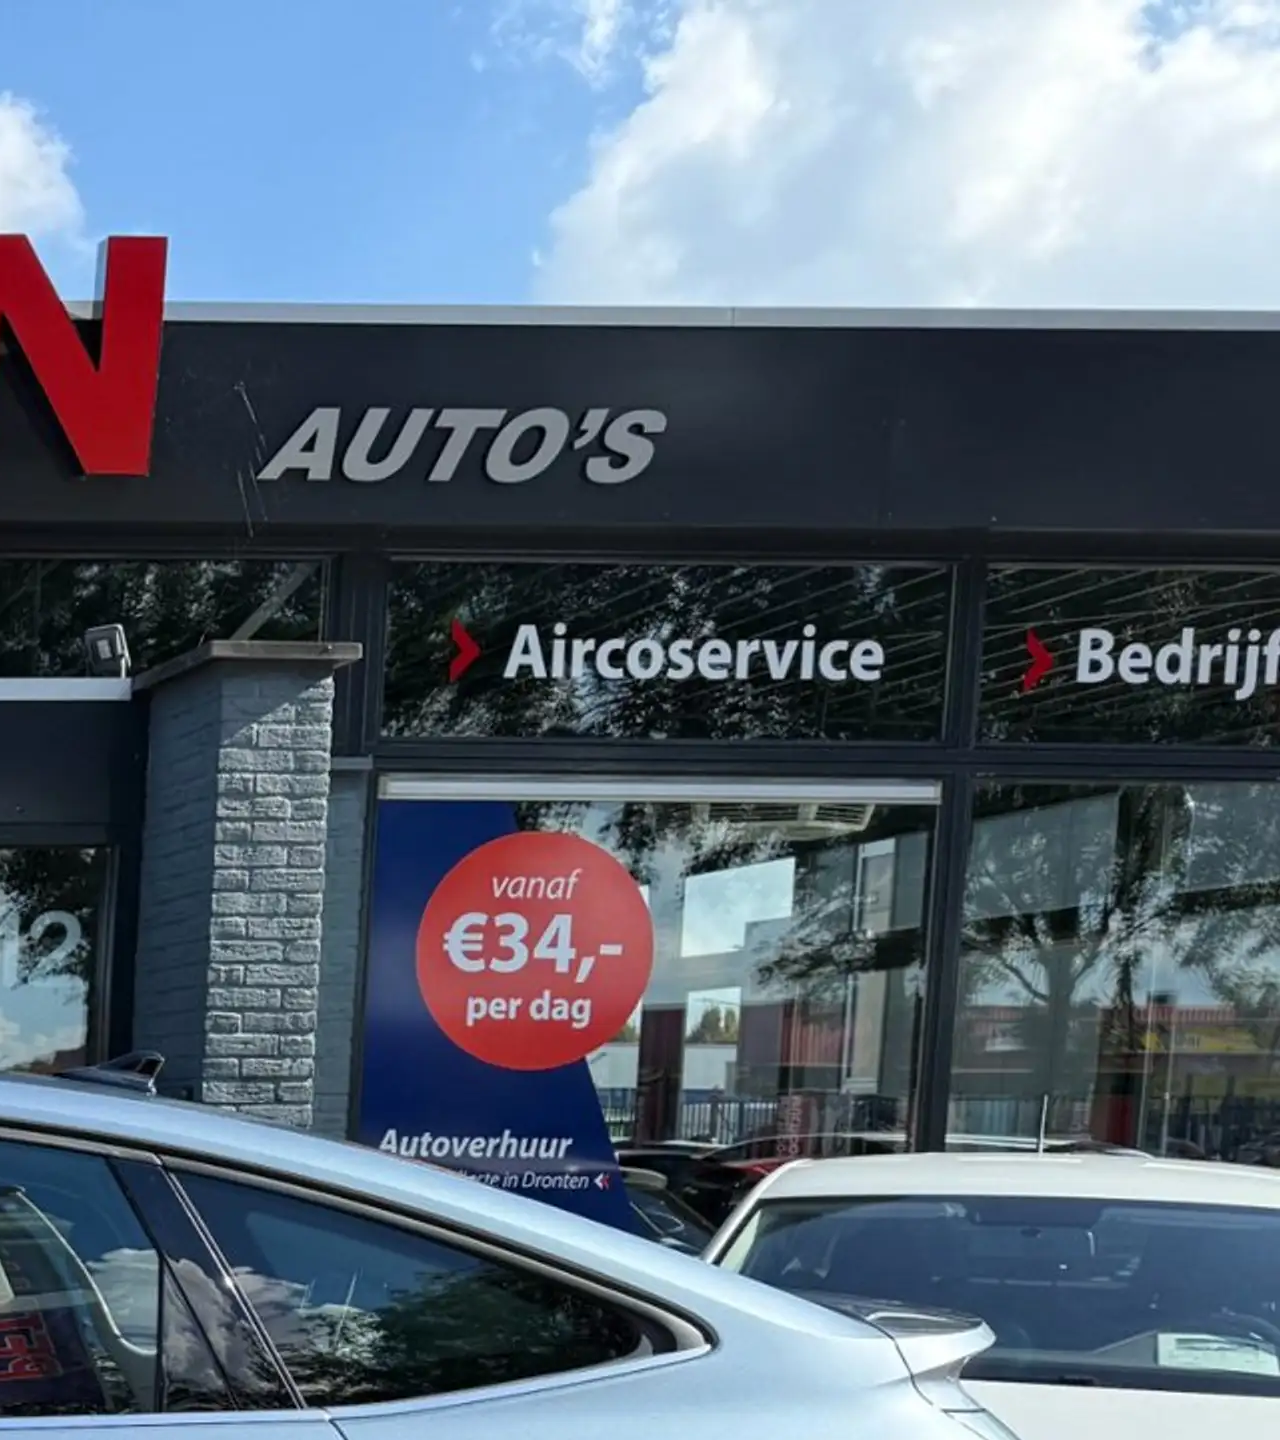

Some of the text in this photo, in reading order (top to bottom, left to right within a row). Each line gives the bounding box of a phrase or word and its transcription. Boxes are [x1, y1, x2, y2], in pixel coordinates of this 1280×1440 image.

[256, 406, 668, 484] AUTO'S
[503, 622, 886, 683] Aircoservice
[1075, 627, 1280, 701] Bedrijf
[491, 867, 583, 900] vanaf
[442, 911, 624, 984] €34,-
[465, 988, 592, 1029] per dag
[379, 1128, 574, 1160] Autoverhuur
[502, 1169, 519, 1188] in
[521, 1170, 590, 1190] Dronten
